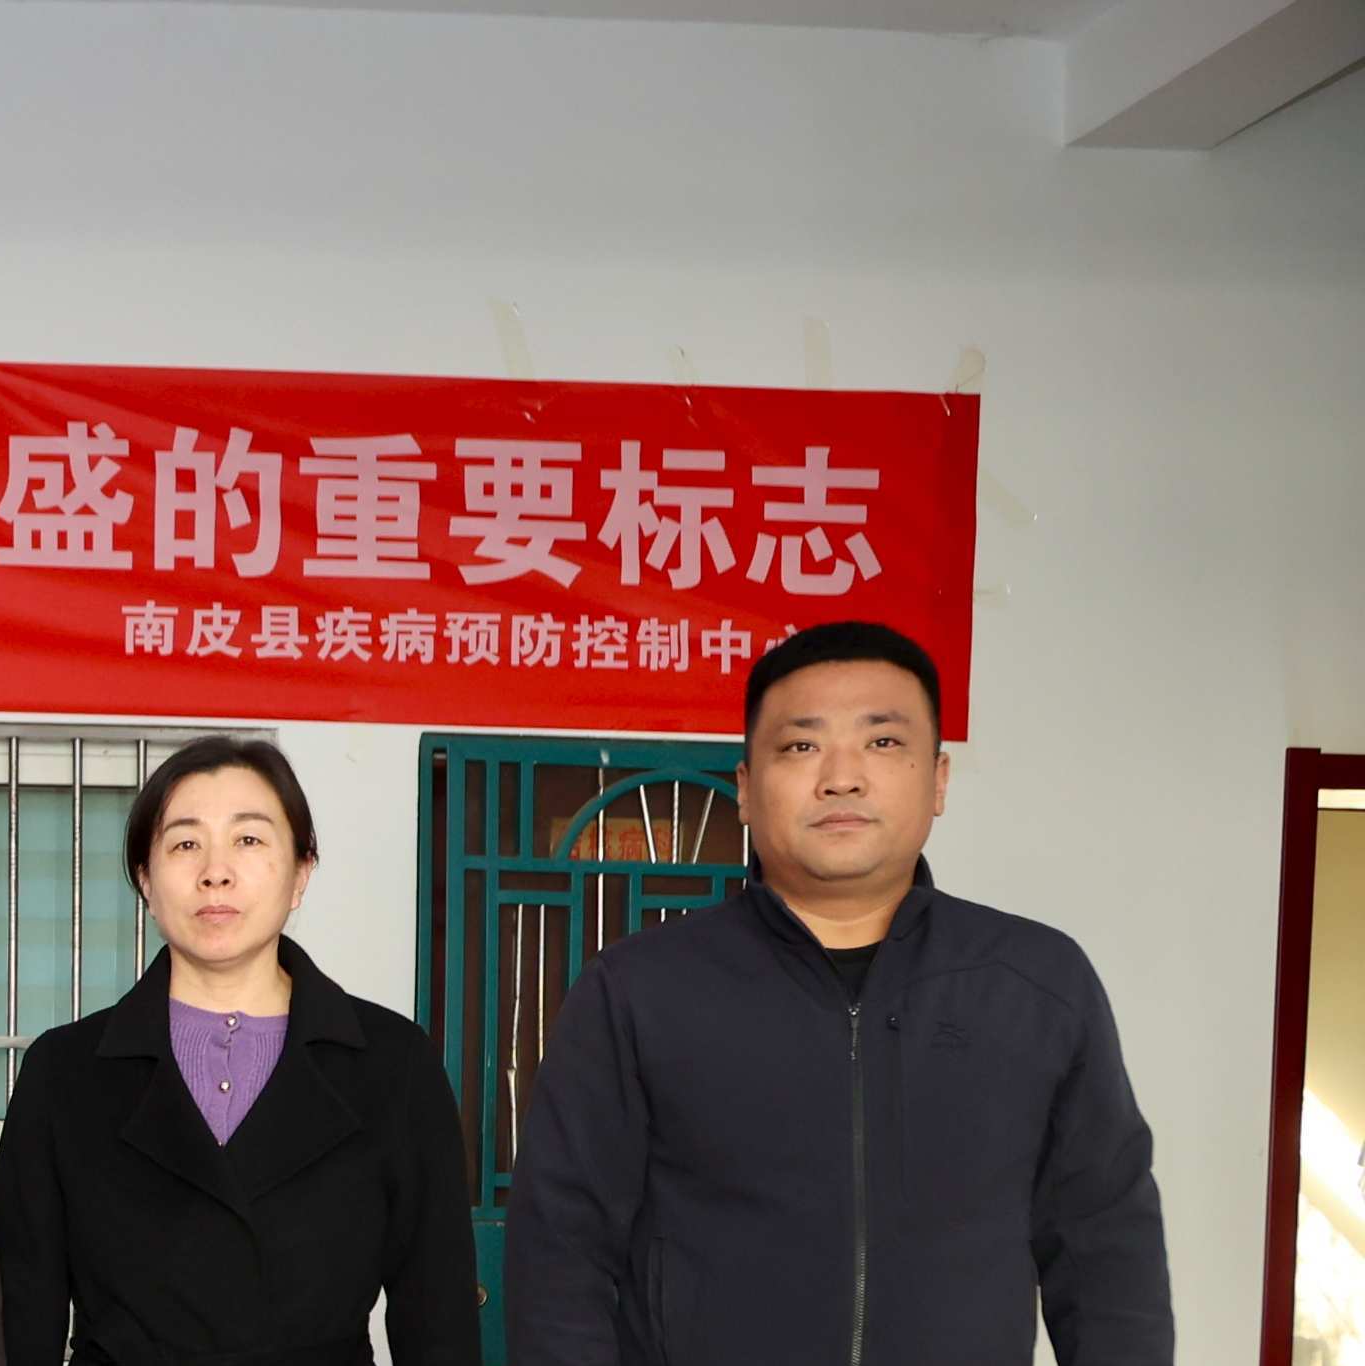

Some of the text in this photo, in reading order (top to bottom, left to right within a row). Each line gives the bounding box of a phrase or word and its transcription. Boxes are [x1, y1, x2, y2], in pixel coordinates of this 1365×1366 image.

[121, 600, 800, 675] 南皮县疾病预防控制中
